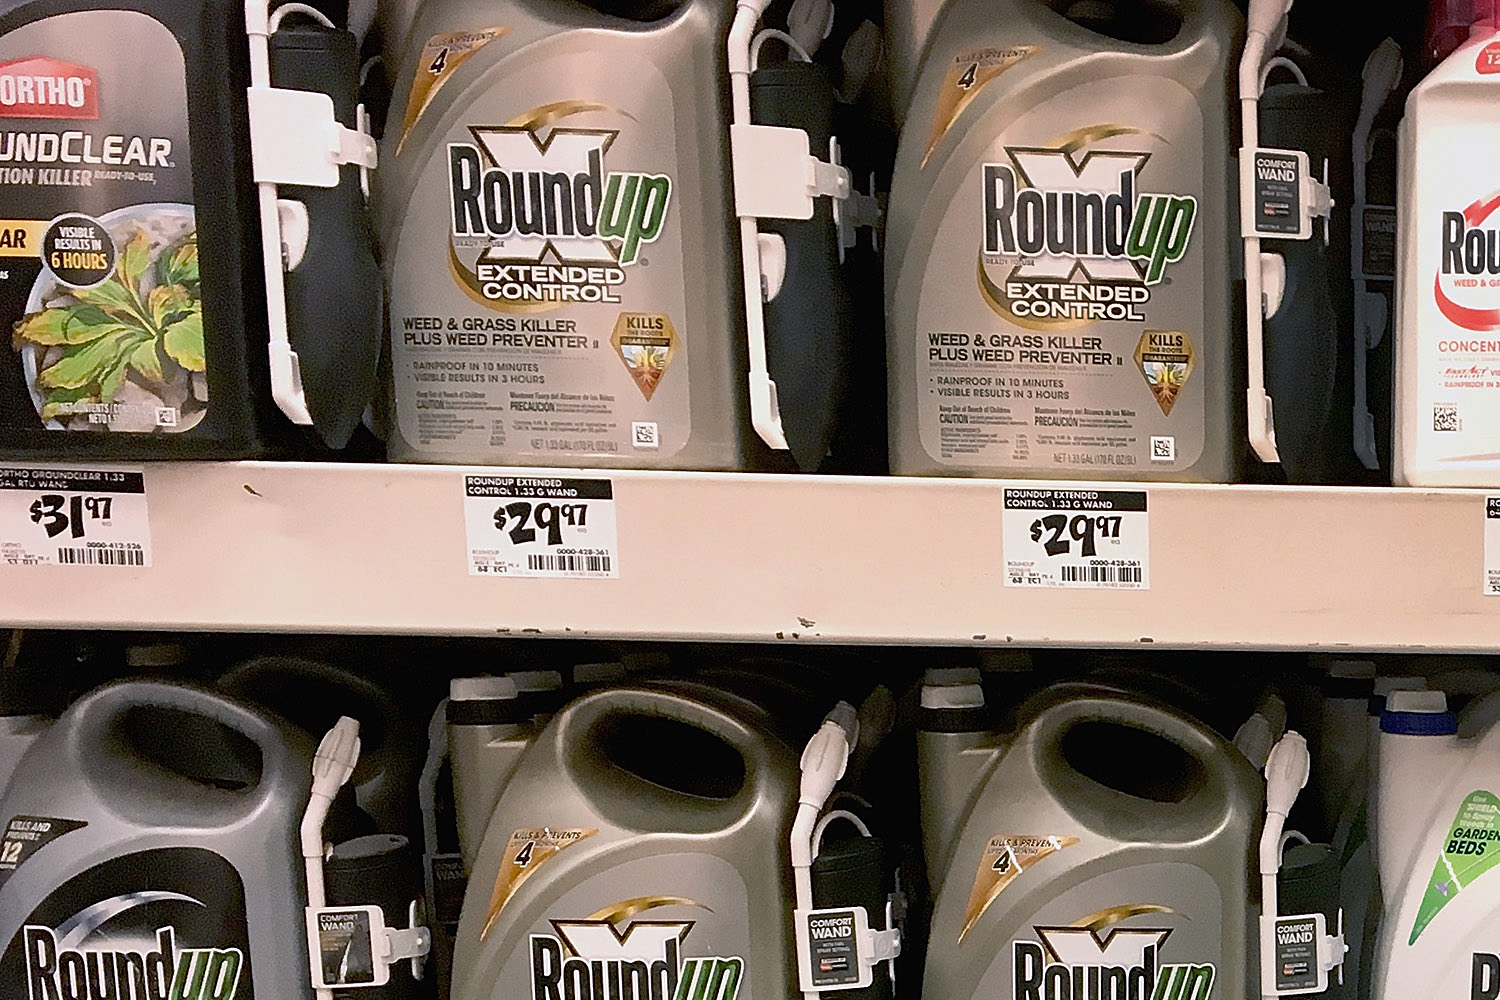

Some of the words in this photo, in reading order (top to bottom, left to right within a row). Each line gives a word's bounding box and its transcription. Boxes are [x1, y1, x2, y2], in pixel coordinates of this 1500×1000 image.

[430, 48, 447, 74] 4
[0, 74, 86, 107] ORTHO
[37, 168, 91, 186] KILLER
[449, 143, 670, 264] Roundup
[59, 226, 94, 239] VISIBLE
[984, 164, 1196, 284] Roundup
[54, 238, 87, 252] RESULTS
[89, 238, 102, 252] IN
[51, 252, 60, 268] 6
[63, 250, 108, 270] HOURS
[477, 265, 624, 283] EXTENDED
[482, 283, 621, 302] CONTROL
[1007, 283, 1149, 301] EXTENDED
[1012, 302, 1145, 320] CONTROL
[402, 317, 443, 332] WEED
[447, 317, 457, 332] &
[462, 317, 514, 332] GRASS
[519, 318, 576, 332] KILLER
[627, 315, 663, 330] KILLS
[404, 332, 440, 347] PLUS
[444, 332, 486, 347] WEED
[490, 334, 587, 348] PREVENTER
[467, 478, 514, 487] ROUNDUP
[518, 479, 562, 487] EXTENDED
[467, 486, 511, 496] CONTROL
[515, 486, 536, 496] 1.33
[538, 487, 545, 496] G
[547, 488, 577, 497] WAND
[1447, 839, 1486, 855] BEDS
[811, 917, 853, 929] COMFORT
[812, 927, 852, 939] WAND
